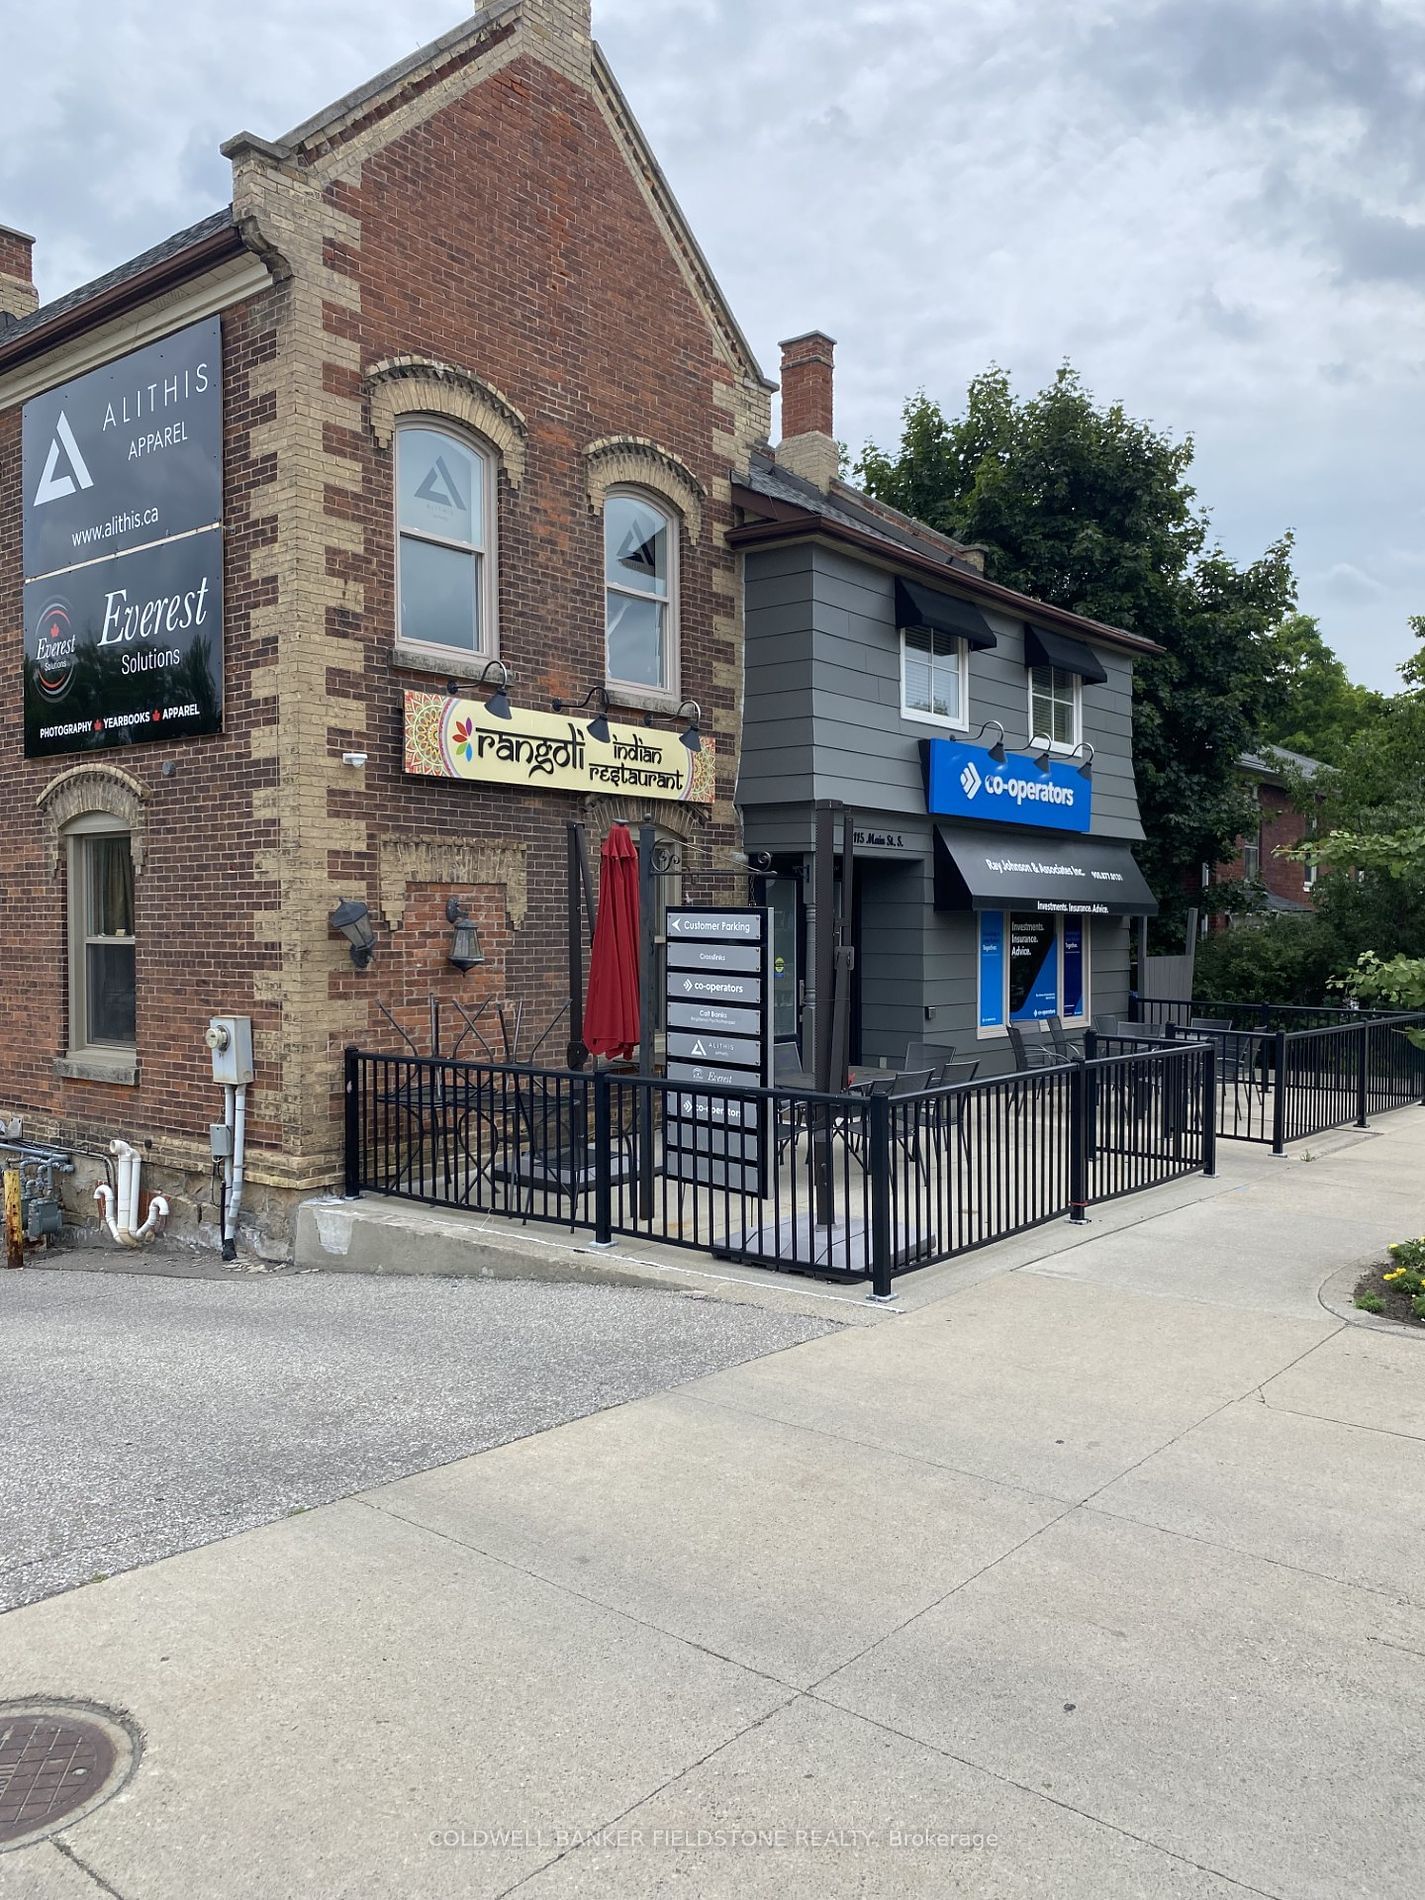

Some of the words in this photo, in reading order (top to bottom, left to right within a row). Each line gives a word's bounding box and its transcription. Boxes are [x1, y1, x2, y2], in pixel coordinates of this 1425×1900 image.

[103, 363, 208, 431] ALITHIS
[128, 421, 188, 461] APPAREL
[72, 507, 159, 547] www.alithis.ca
[97, 577, 209, 647] Everest
[36, 634, 76, 660] Everest
[122, 649, 180, 675] Solutions
[40, 720, 93, 739] PHOTOGRAPHY
[103, 711, 150, 729] YEARBOOKS
[162, 704, 200, 720] APPAREL
[475, 723, 586, 778] rangoli
[613, 733, 662, 764] indian
[588, 759, 684, 791] restaurant
[985, 774, 1074, 806] co-operators
[853, 832, 864, 844] 115
[866, 832, 885, 845] Main
[985, 859, 1003, 874] Ray
[1001, 860, 1033, 873] Johnson
[1030, 862, 1040, 873] &
[1038, 863, 1074, 876] Associates
[684, 920, 720, 931] Customer
[721, 921, 750, 933] Parking
[1011, 934, 1039, 944] Insurance.
[1011, 945, 1031, 956] Advice.
[694, 982, 743, 993] co-operators
